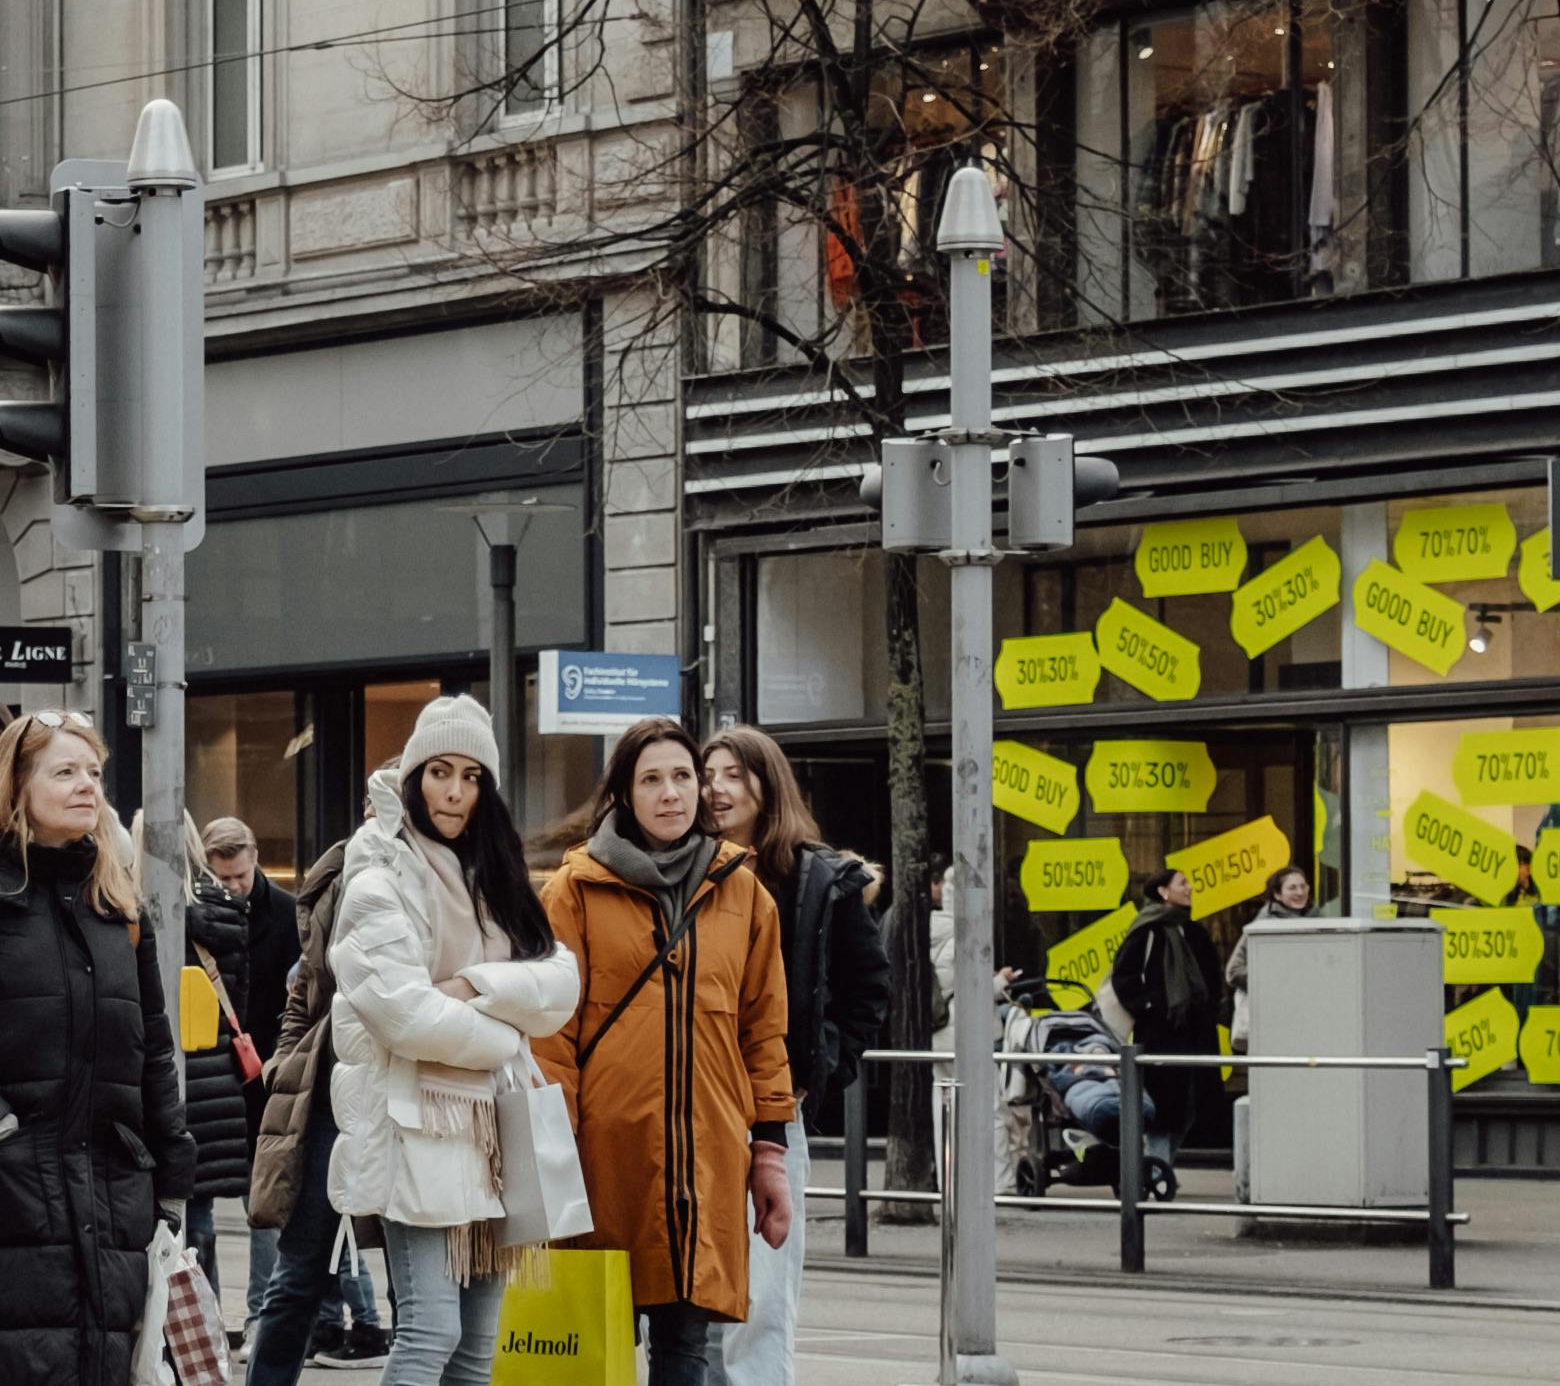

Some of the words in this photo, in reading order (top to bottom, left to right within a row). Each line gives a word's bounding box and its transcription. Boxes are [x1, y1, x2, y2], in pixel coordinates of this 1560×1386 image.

[1149, 547, 1192, 573] GOOD
[1200, 541, 1233, 569] BUY
[1366, 582, 1412, 626] GOOD
[1417, 609, 1454, 648] BUY
[1036, 776, 1068, 809] BUY
[1416, 813, 1463, 857] GOOD
[1468, 840, 1506, 879] BUY
[502, 1331, 579, 1356] Jelmoli
